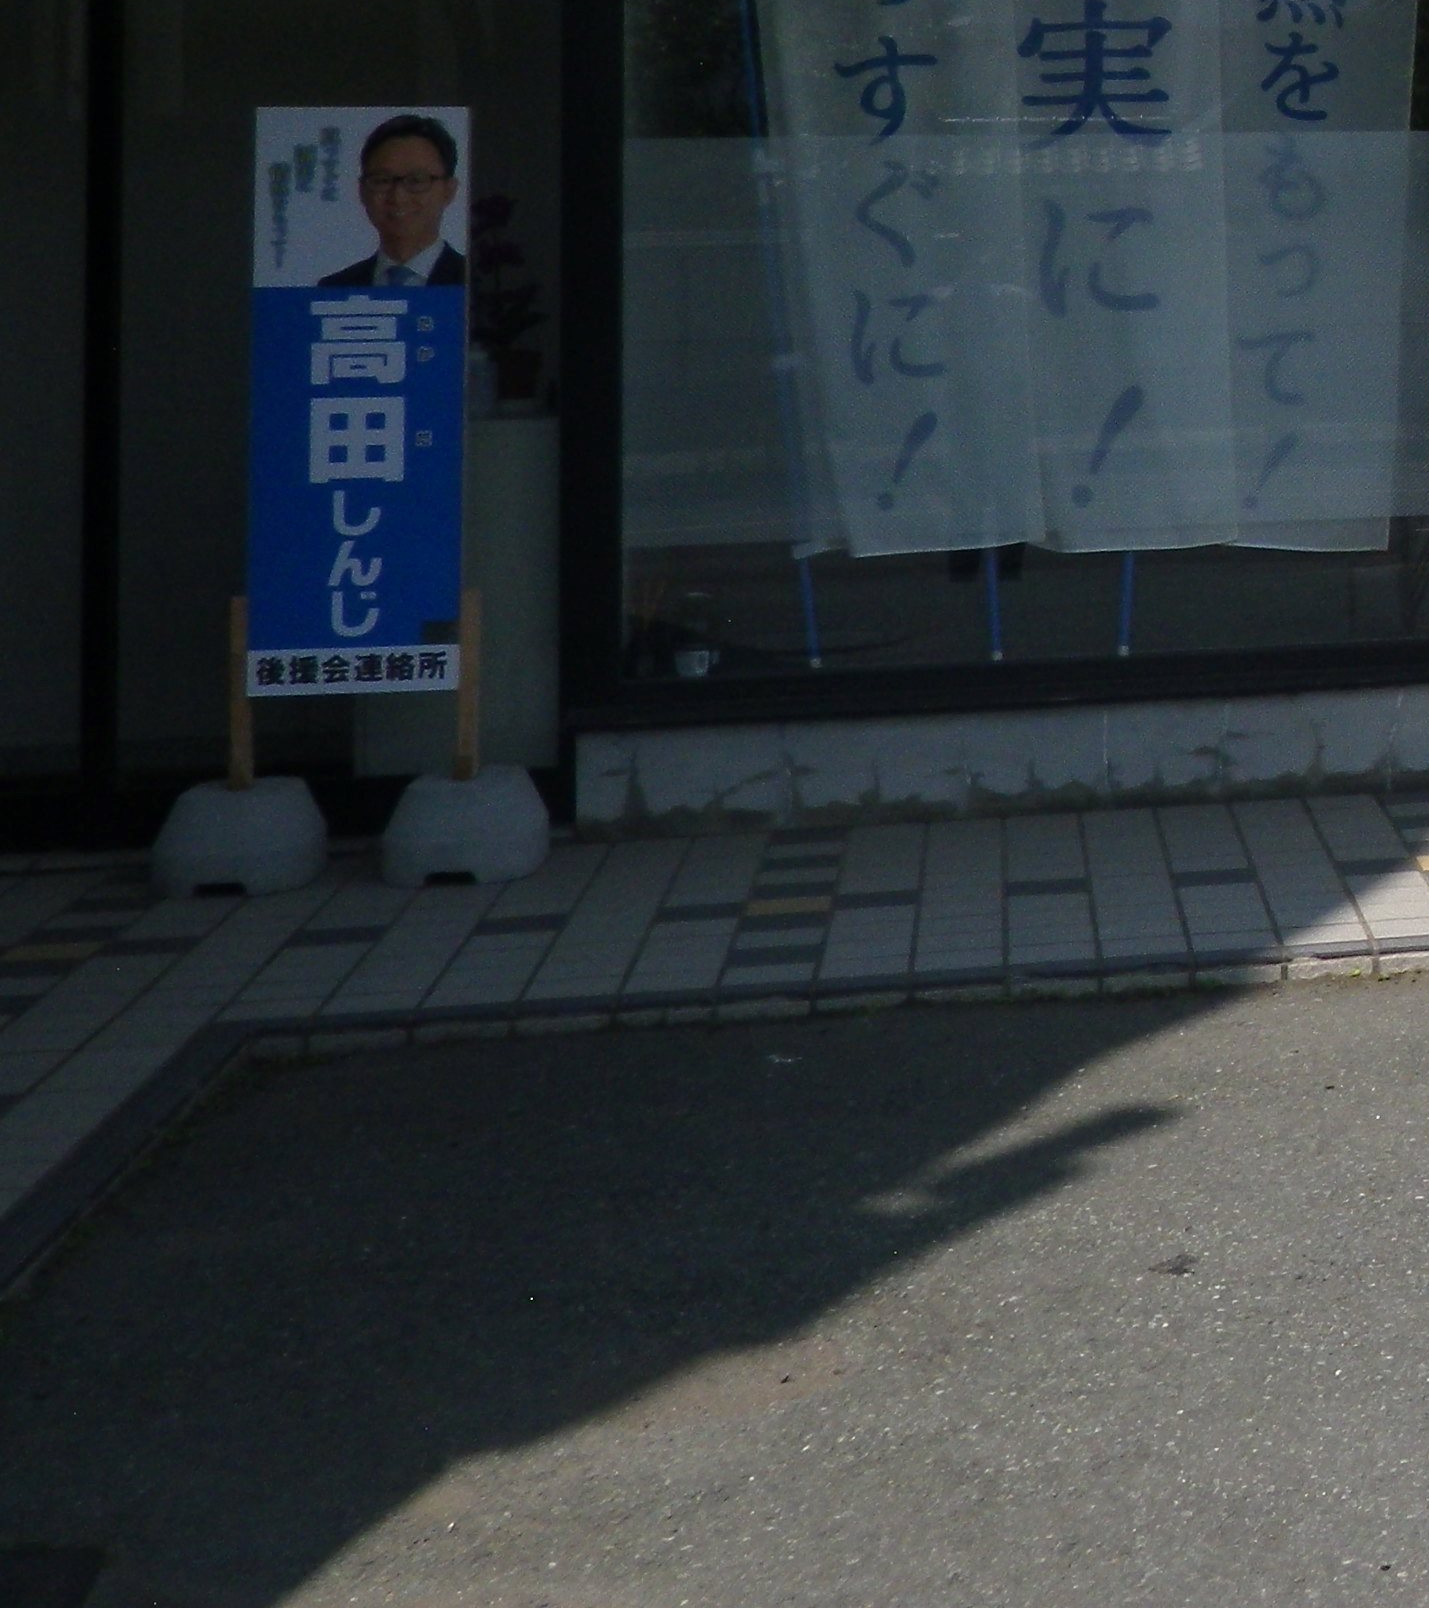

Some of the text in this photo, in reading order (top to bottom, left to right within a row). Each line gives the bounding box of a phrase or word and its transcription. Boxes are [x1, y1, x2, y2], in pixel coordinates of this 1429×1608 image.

[309, 294, 408, 638] 高田しんじ
[255, 650, 450, 687] 後援会連絡所
